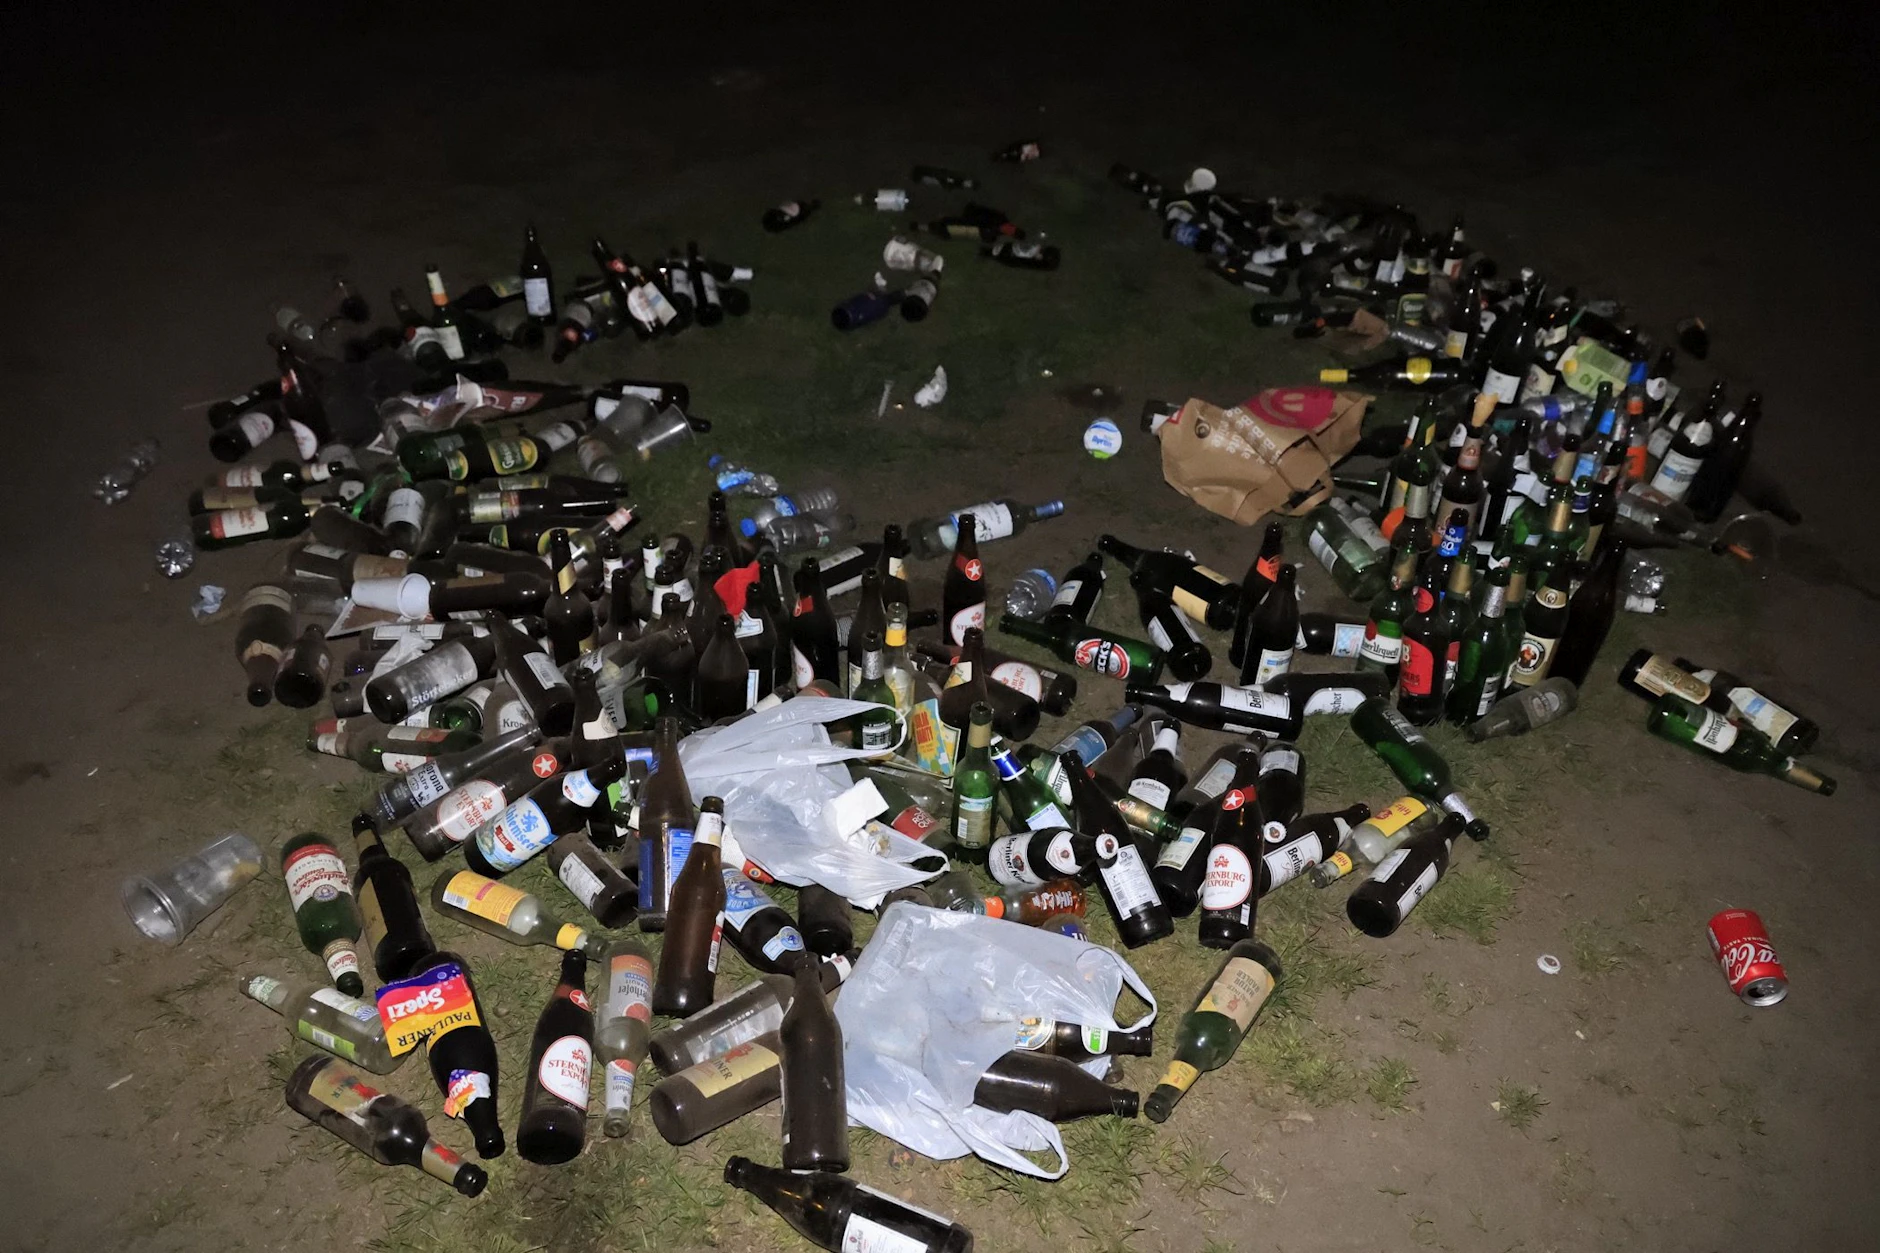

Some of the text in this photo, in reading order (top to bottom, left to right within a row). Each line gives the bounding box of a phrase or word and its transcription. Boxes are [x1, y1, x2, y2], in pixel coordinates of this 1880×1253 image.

[1373, 642, 1400, 659] Urquell
[1207, 870, 1247, 883] ERNBURG
[617, 984, 648, 998] erhofer
[386, 987, 446, 1023] Spezi
[396, 1011, 473, 1048] PAULANER
